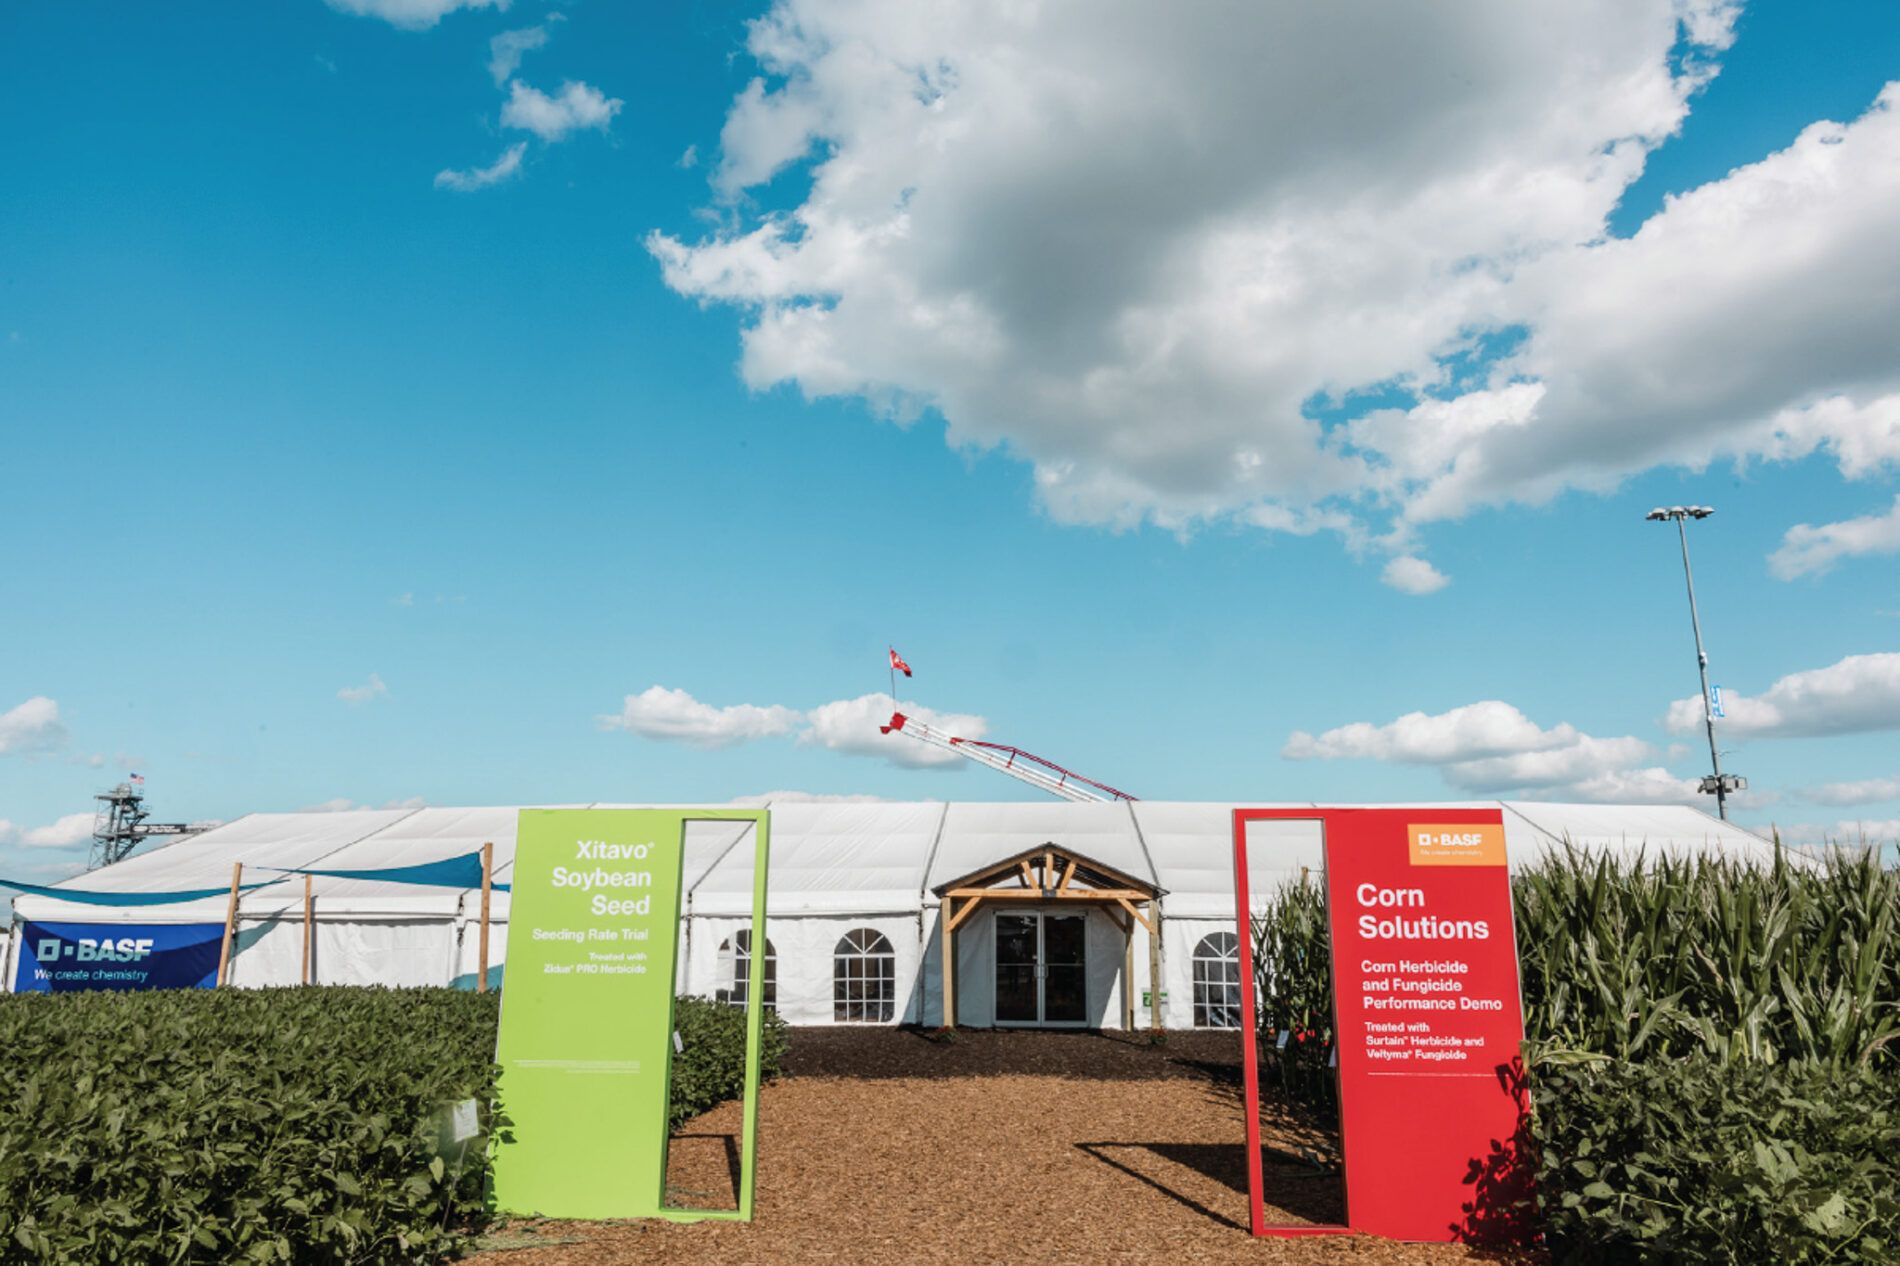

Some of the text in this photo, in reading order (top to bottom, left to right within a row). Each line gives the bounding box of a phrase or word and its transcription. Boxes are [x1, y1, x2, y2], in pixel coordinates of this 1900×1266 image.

[1440, 833, 1482, 846] BASF
[551, 866, 652, 891] Soybean
[1356, 882, 1425, 907] Corn
[591, 894, 651, 915] Seed
[1358, 914, 1489, 939] Solutions
[532, 928, 649, 943] Seeding Rate Trial
[77, 938, 154, 962] BASF
[589, 951, 647, 961] Treated with
[576, 963, 598, 974] PRO
[1361, 959, 1469, 973] Corn Herbicide
[34, 968, 149, 983] We create chemistry
[1362, 977, 1463, 994] and Fungicide
[1363, 996, 1503, 1010] Performance Demo
[1364, 1021, 1430, 1033] Treated with
[1410, 1036, 1462, 1047] Herbicide
[1464, 1036, 1485, 1047] and
